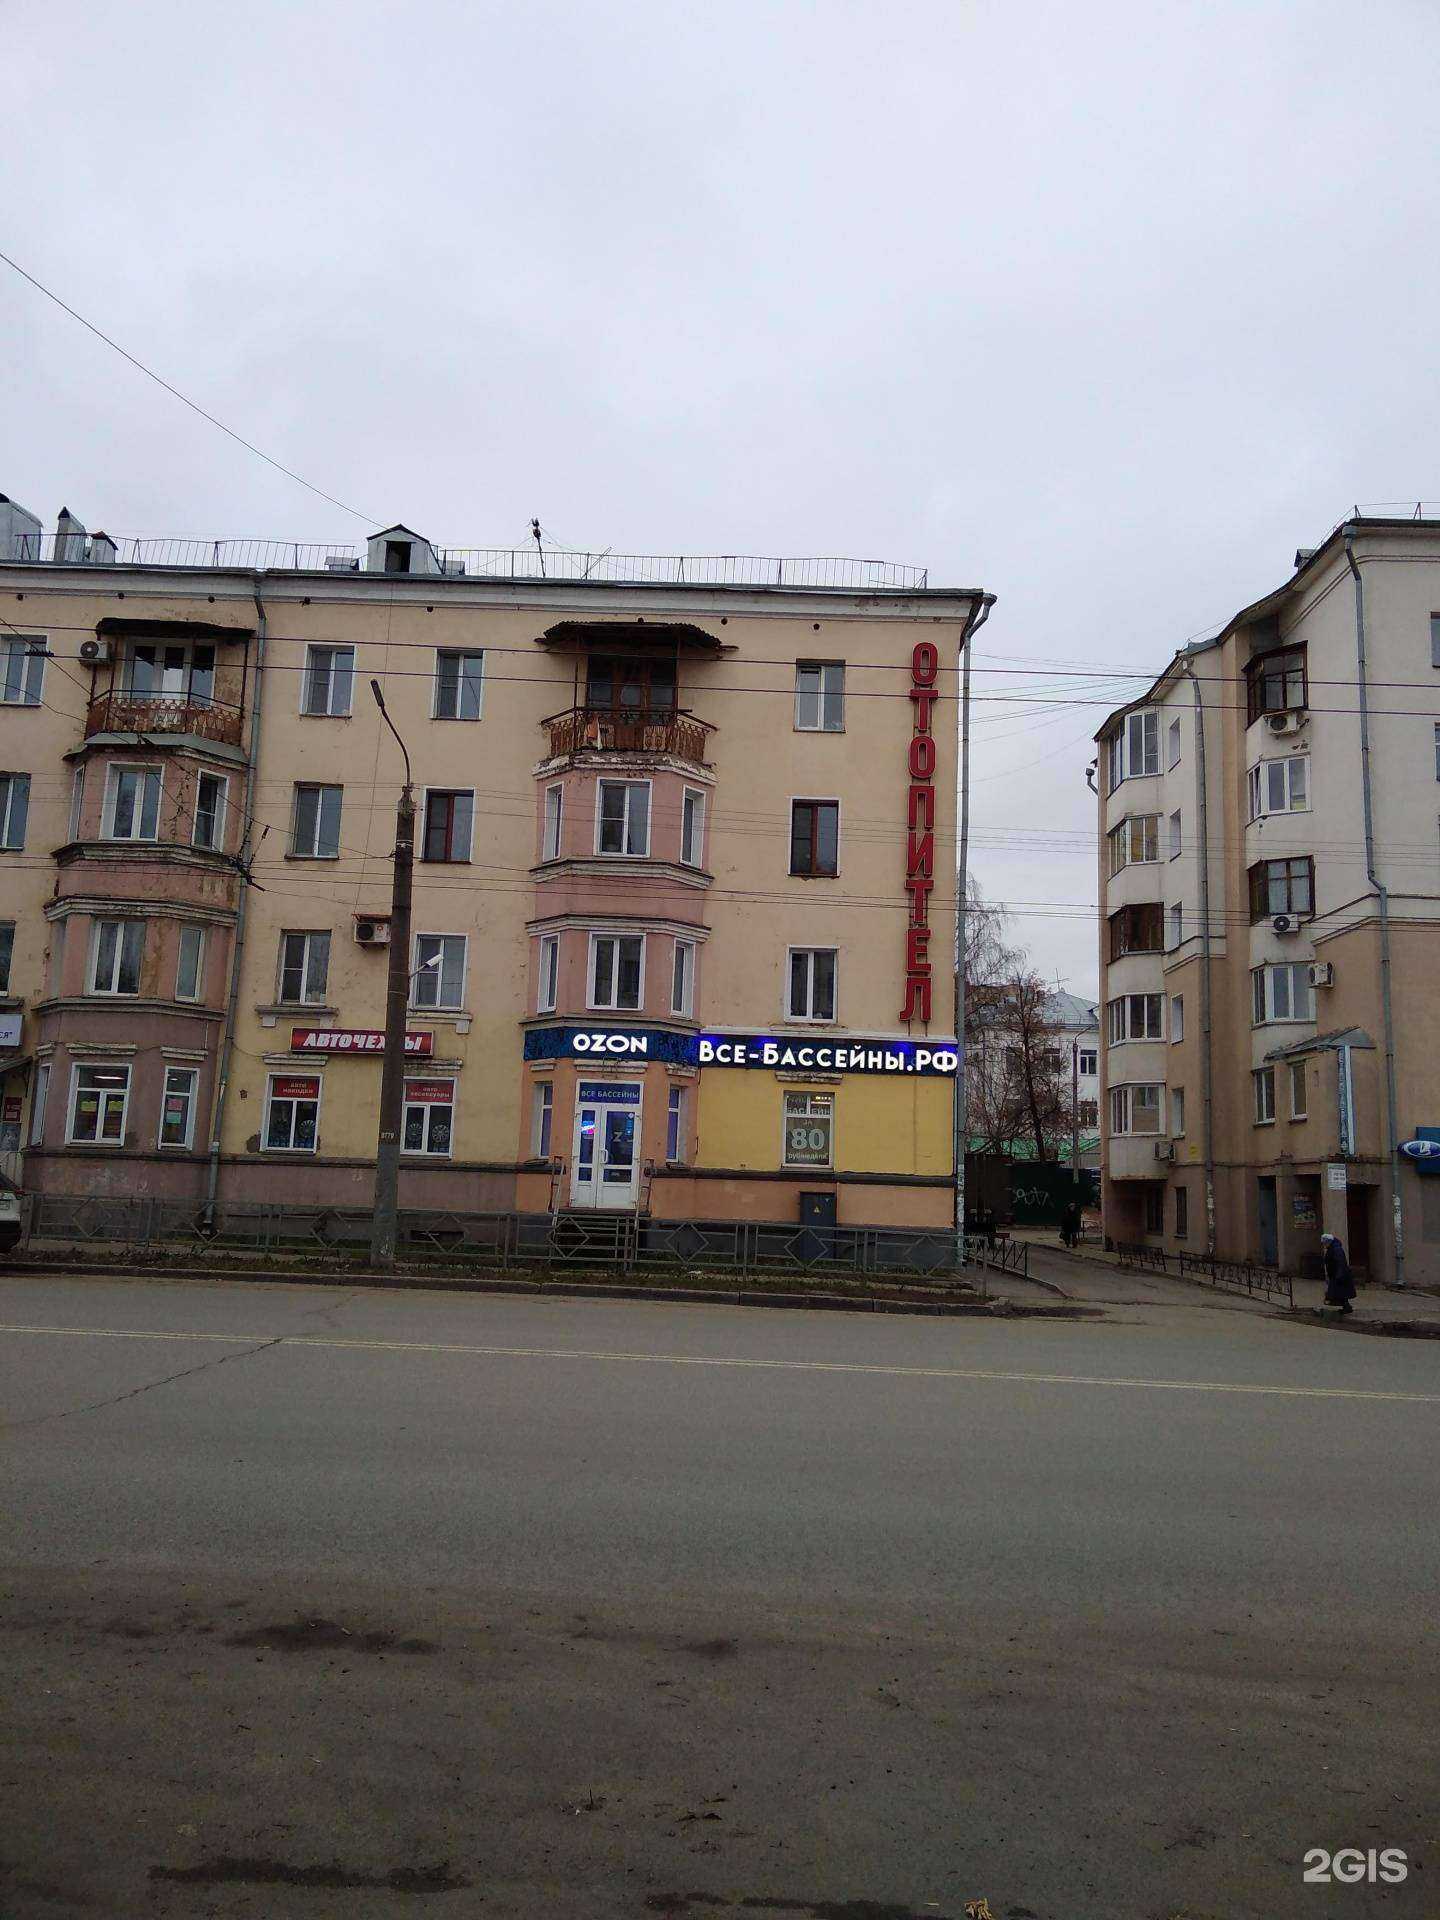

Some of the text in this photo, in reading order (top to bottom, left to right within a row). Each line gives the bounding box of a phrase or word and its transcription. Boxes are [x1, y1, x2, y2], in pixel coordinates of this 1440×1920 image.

[900, 642, 938, 1021] ОТОПИТЕЛ
[303, 1033, 422, 1050] АВТОЧЕХЫ
[572, 1033, 647, 1053] OZON
[597, 1090, 639, 1098] БАССЕЙНЫ
[791, 1128, 825, 1150] 80
